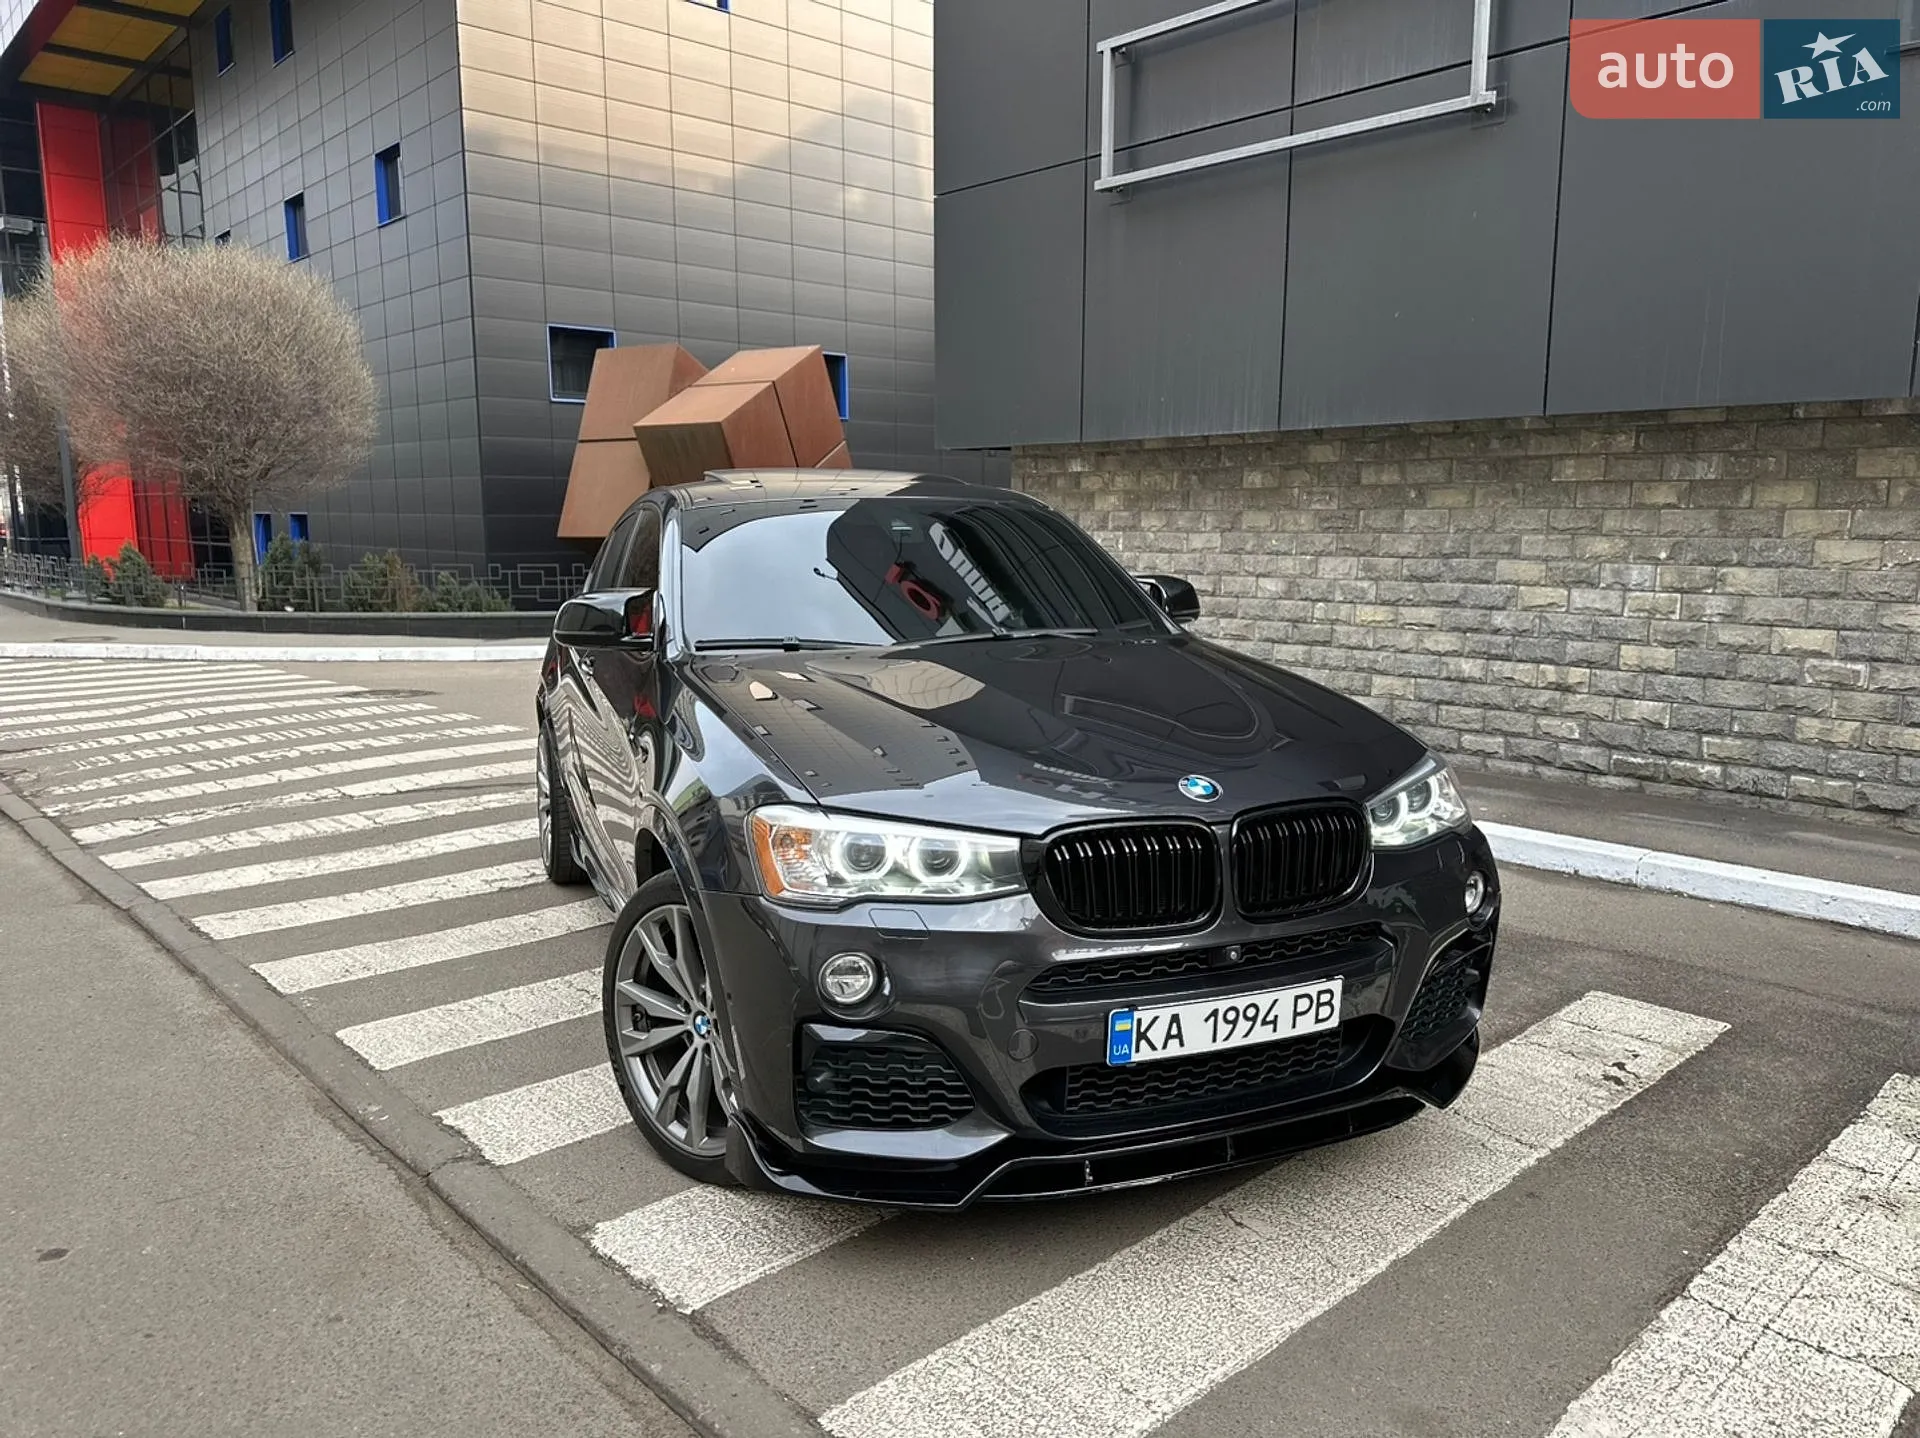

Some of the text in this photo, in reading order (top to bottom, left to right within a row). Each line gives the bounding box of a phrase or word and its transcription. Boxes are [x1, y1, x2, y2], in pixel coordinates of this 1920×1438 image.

[1134, 988, 1336, 1054] KA 1994 PB
[1113, 1044, 1130, 1056] UA
